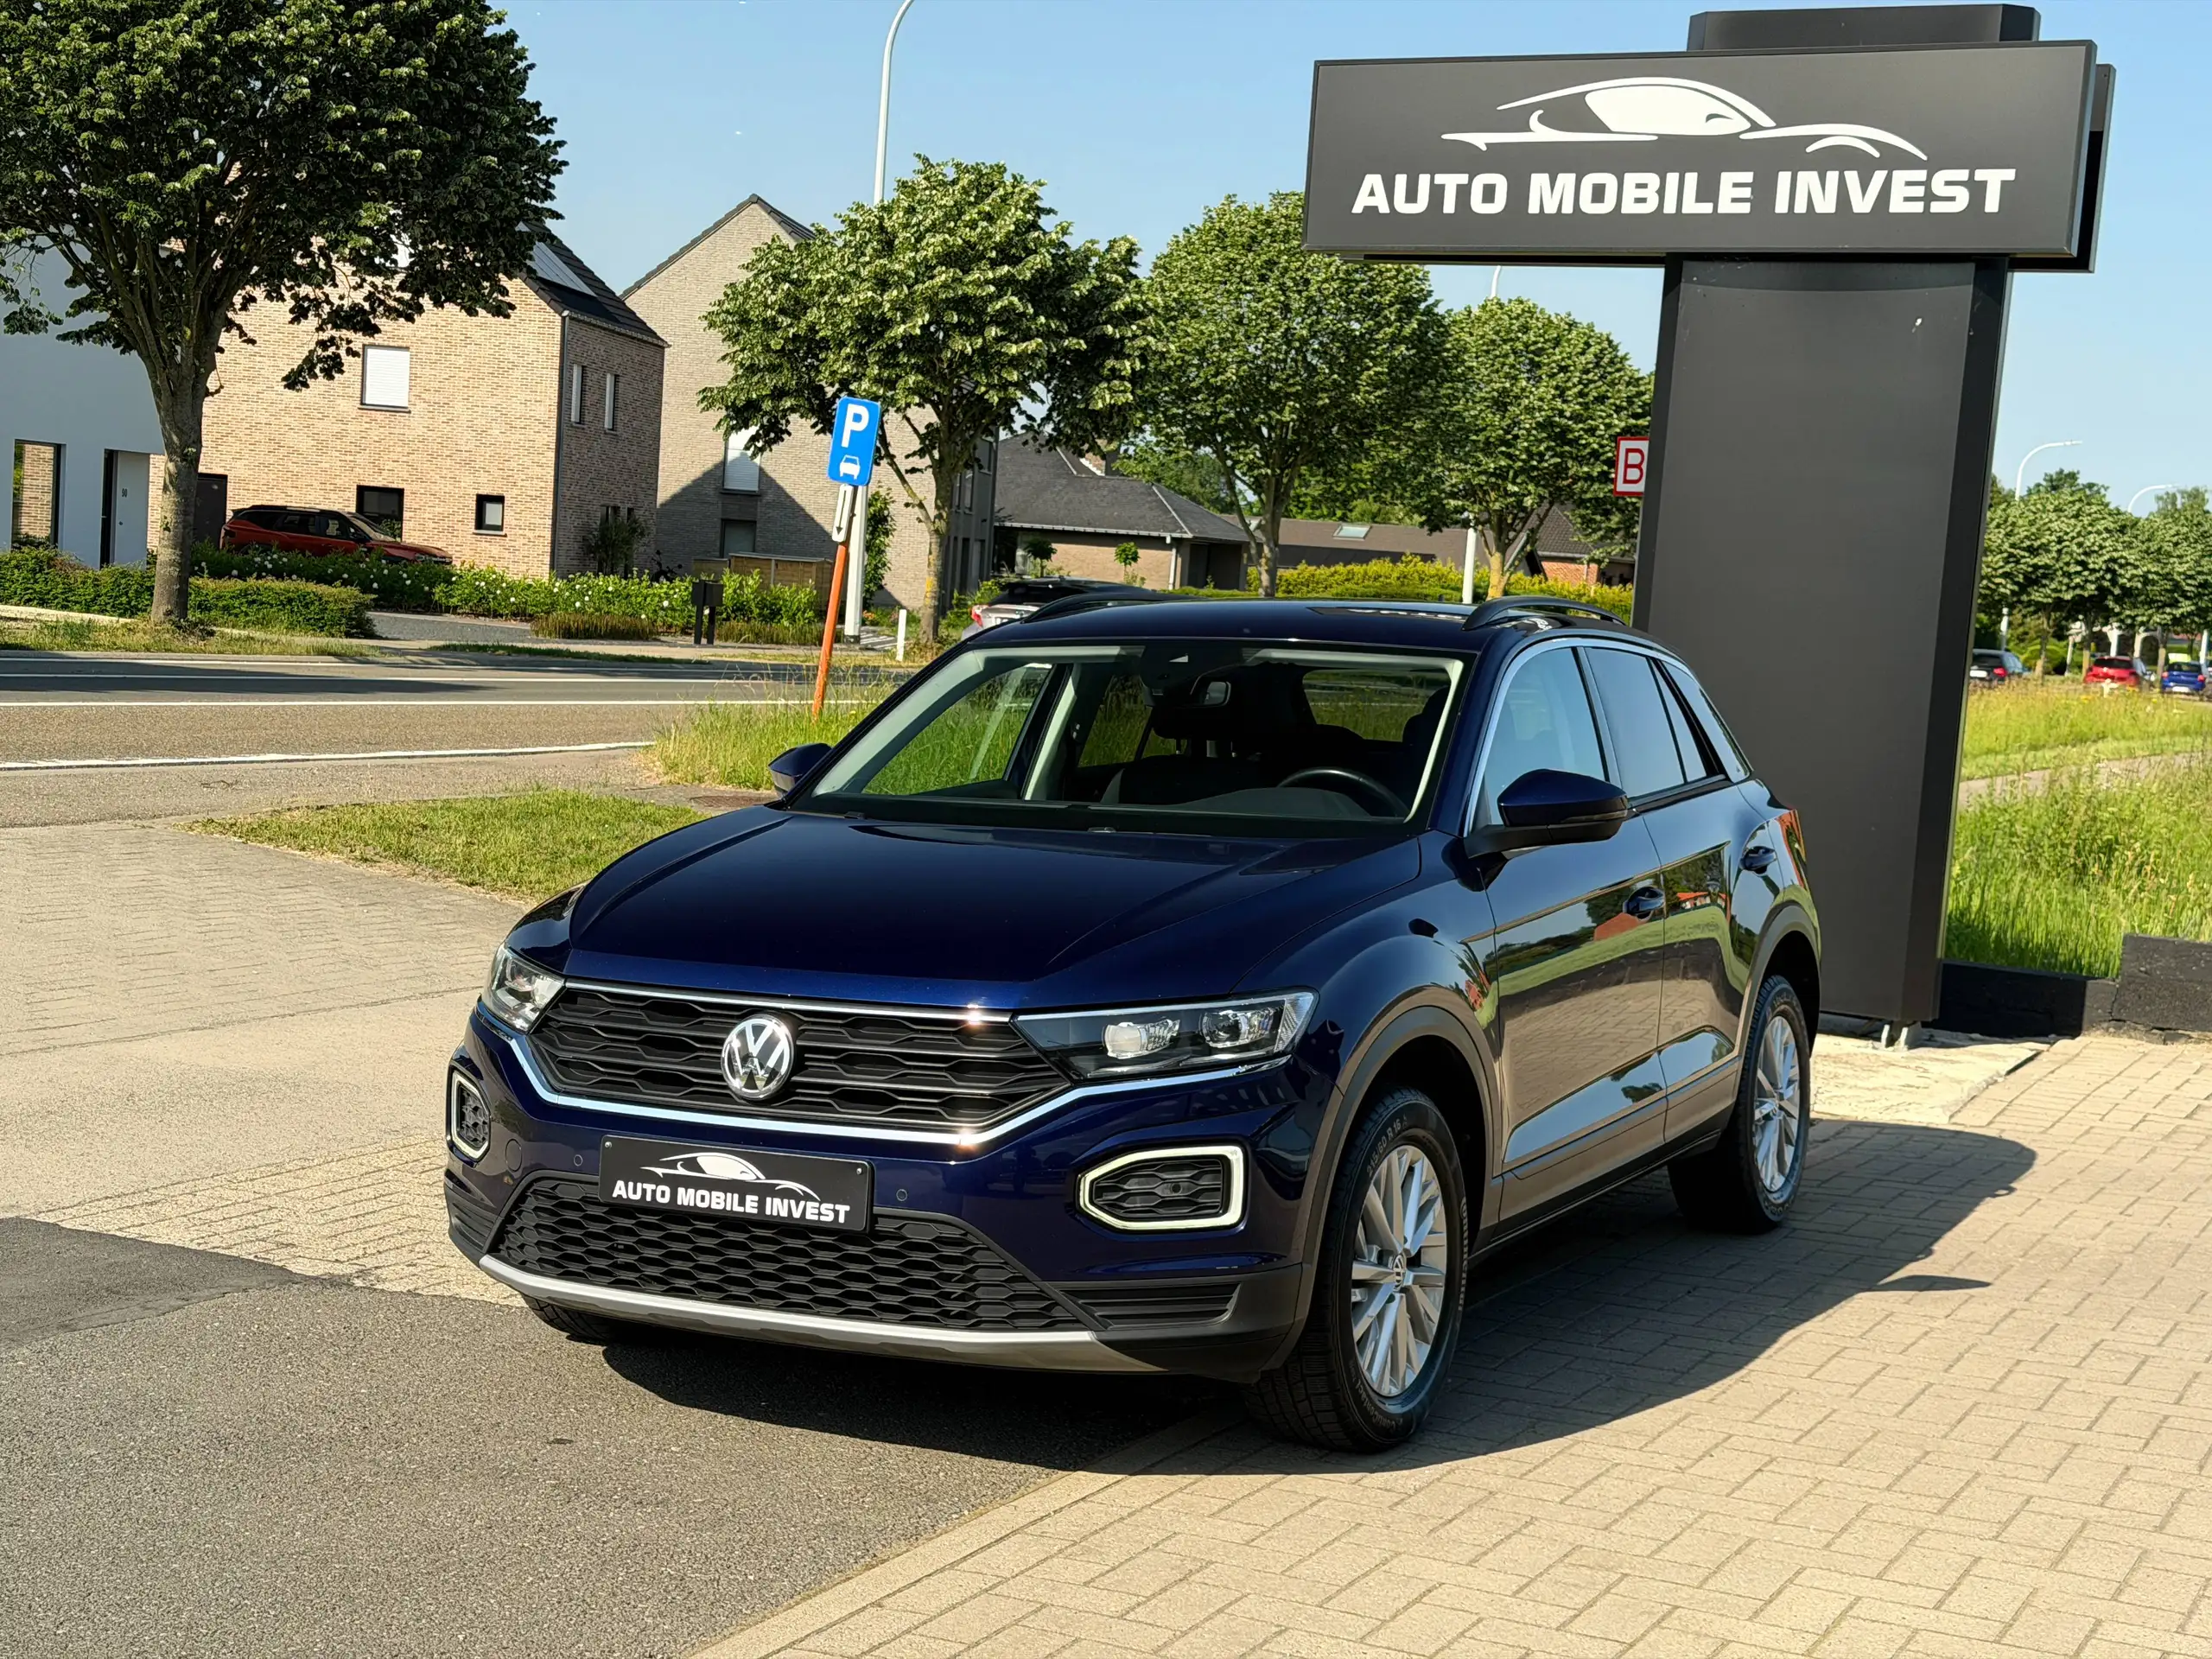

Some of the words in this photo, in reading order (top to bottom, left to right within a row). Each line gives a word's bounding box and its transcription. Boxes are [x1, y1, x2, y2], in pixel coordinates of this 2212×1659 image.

[1351, 172, 1508, 214] AUTO
[1527, 171, 1755, 214] MOBILE
[1774, 168, 2017, 214] INVEST
[841, 404, 869, 448] P
[1622, 448, 1645, 485] B
[612, 1179, 671, 1204] AUTO
[677, 1186, 760, 1214] MOBILE
[765, 1196, 851, 1224] INVEST
